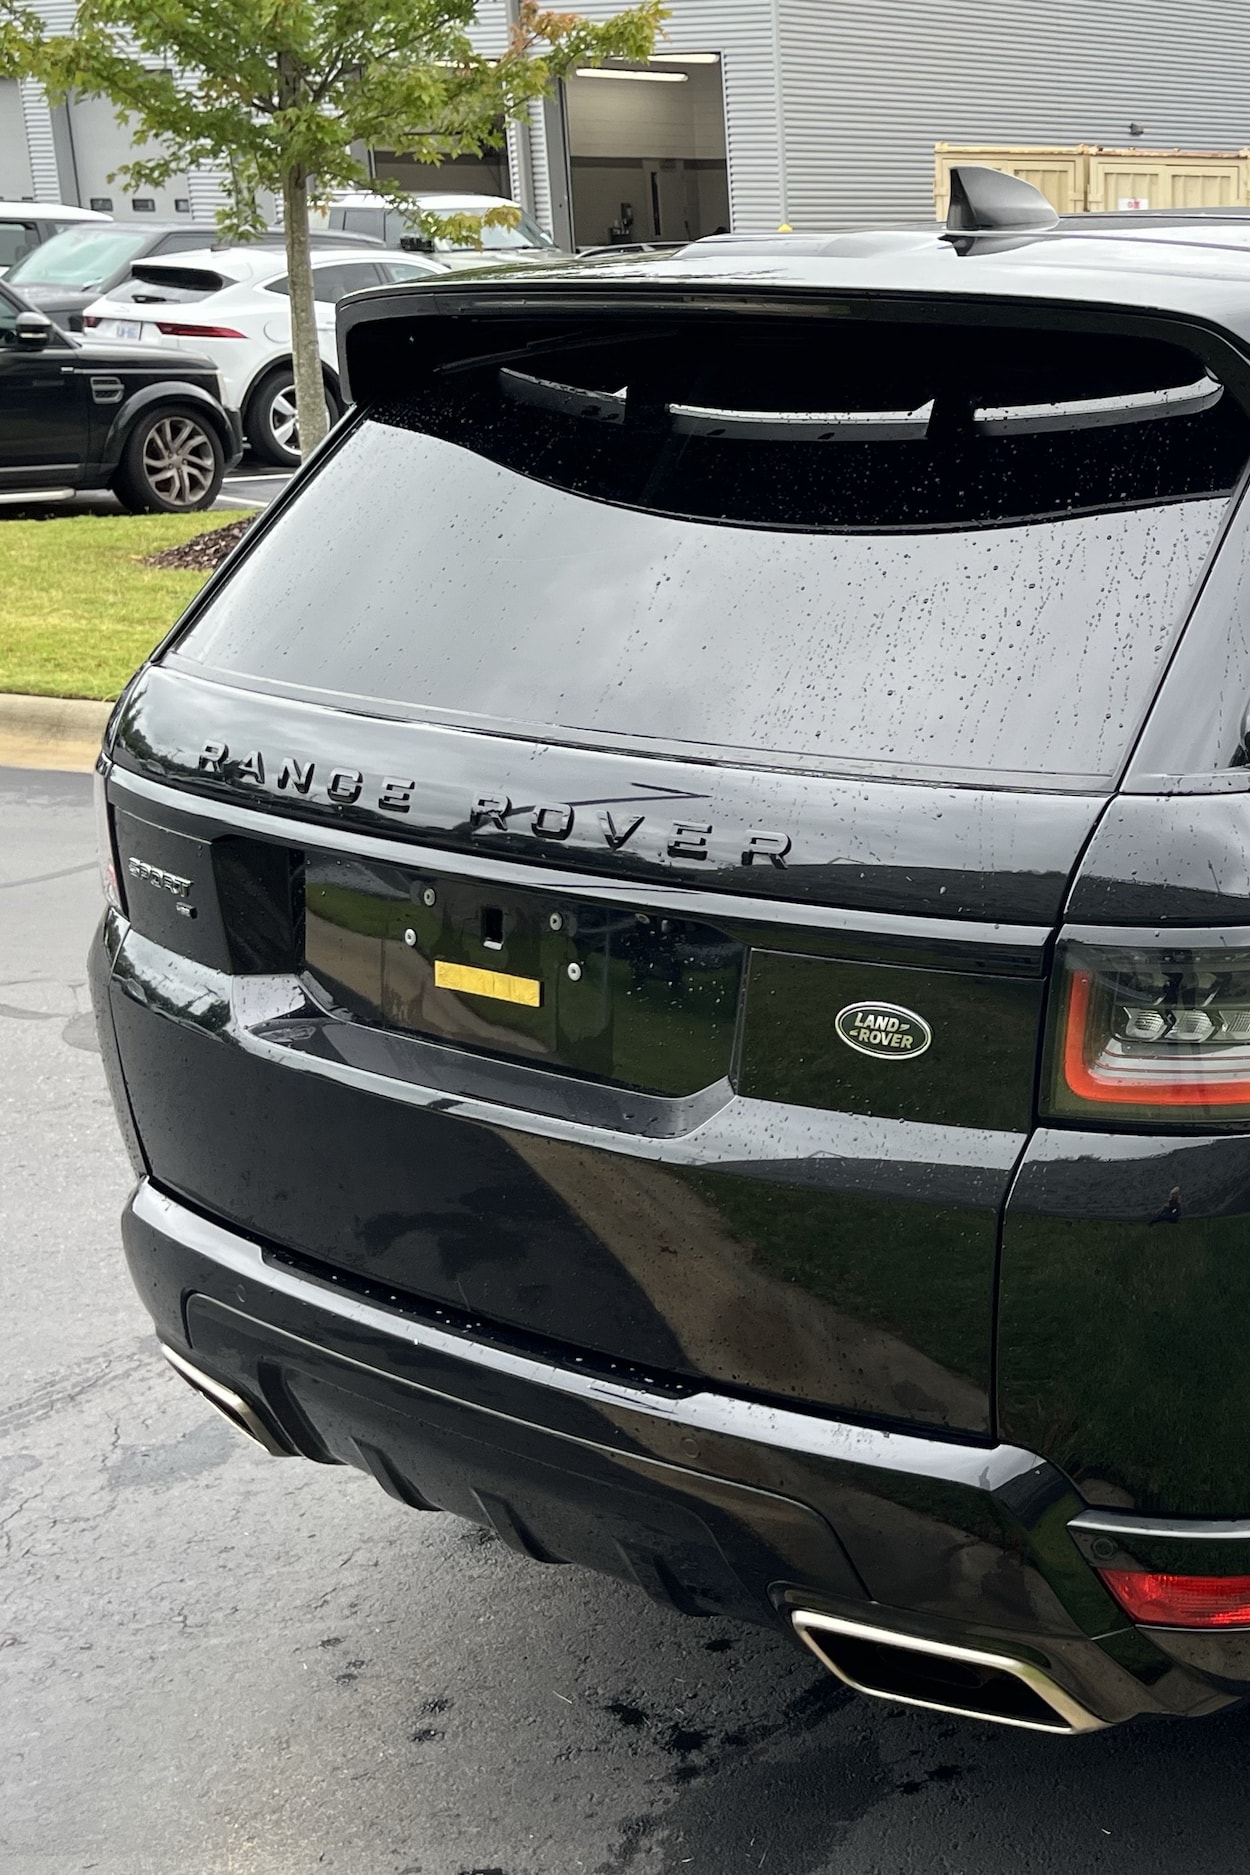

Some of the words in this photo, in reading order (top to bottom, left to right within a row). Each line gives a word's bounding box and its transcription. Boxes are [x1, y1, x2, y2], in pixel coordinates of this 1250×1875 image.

[198, 739, 416, 813] RANGE
[470, 790, 793, 870] ROVER
[128, 856, 194, 898] SPORT
[854, 1012, 900, 1032] LAND
[858, 1028, 914, 1049] ROVER
